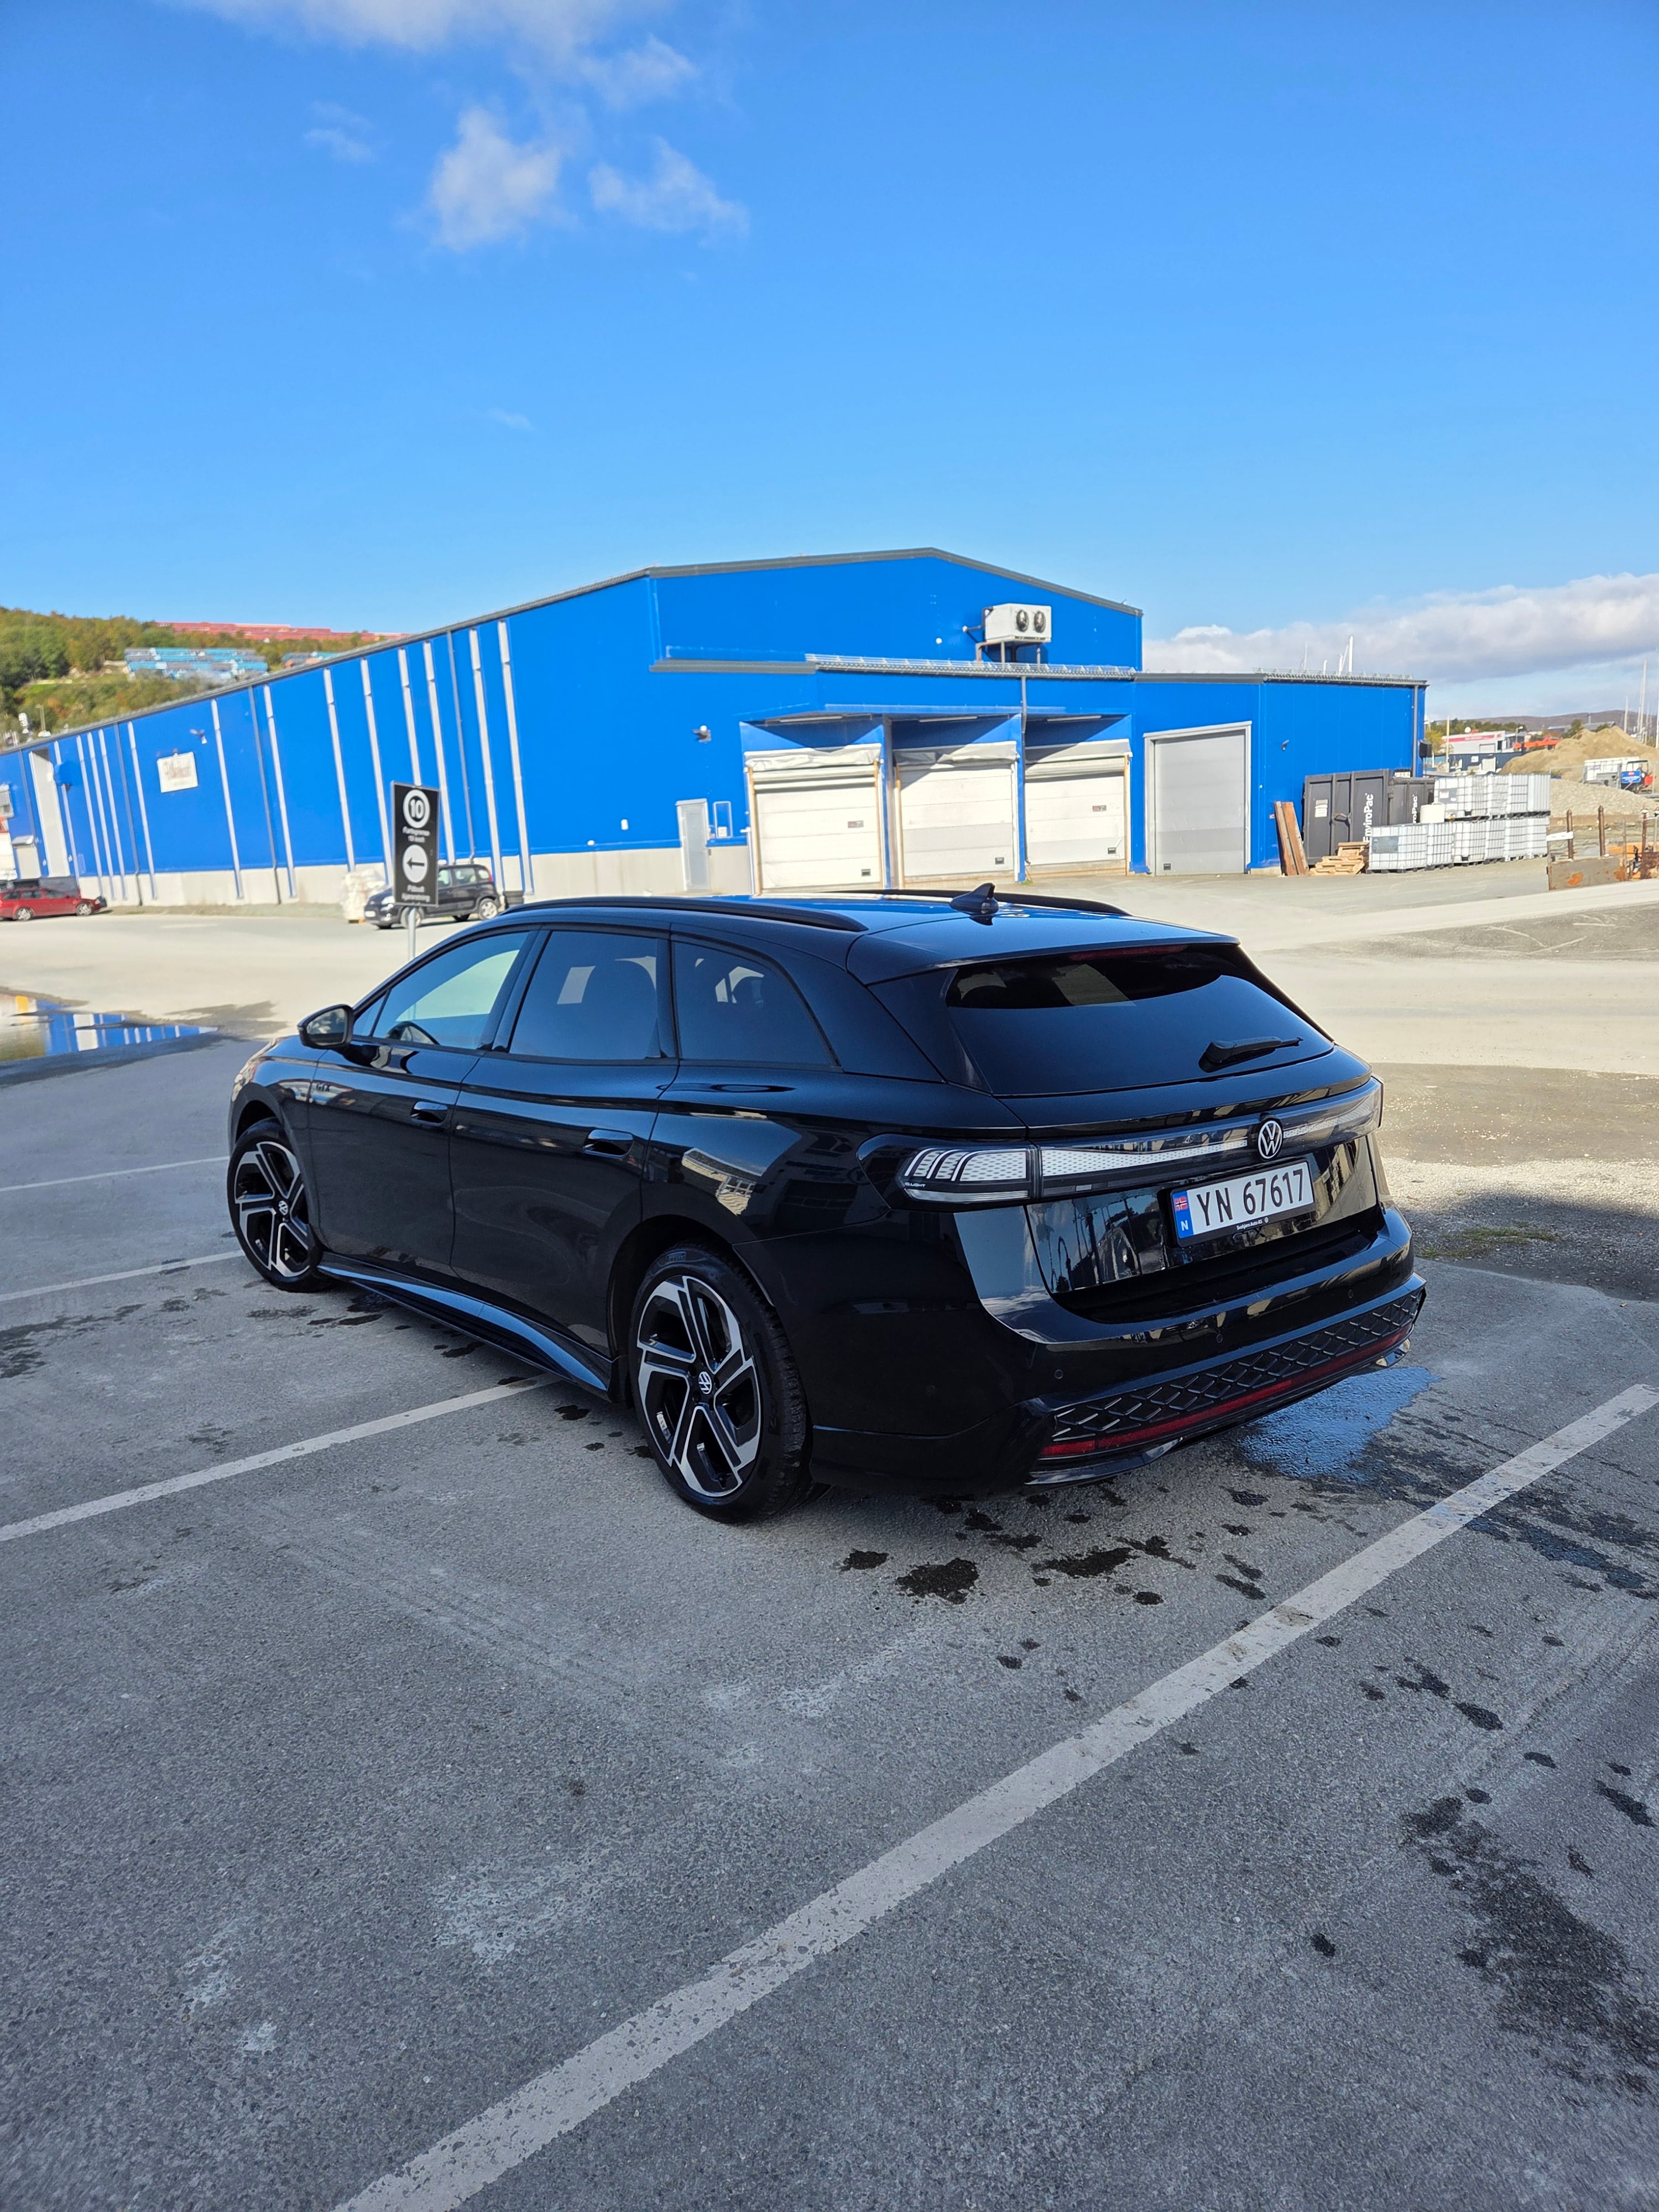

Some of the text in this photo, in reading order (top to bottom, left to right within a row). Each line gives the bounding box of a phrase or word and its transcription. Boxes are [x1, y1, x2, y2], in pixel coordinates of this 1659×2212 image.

[410, 799, 424, 819] 10
[1258, 1120, 1282, 1159] VW
[1196, 1168, 1303, 1227] YN 67617
[1181, 1219, 1189, 1232] N
[1232, 1227, 1266, 1245] GTX
